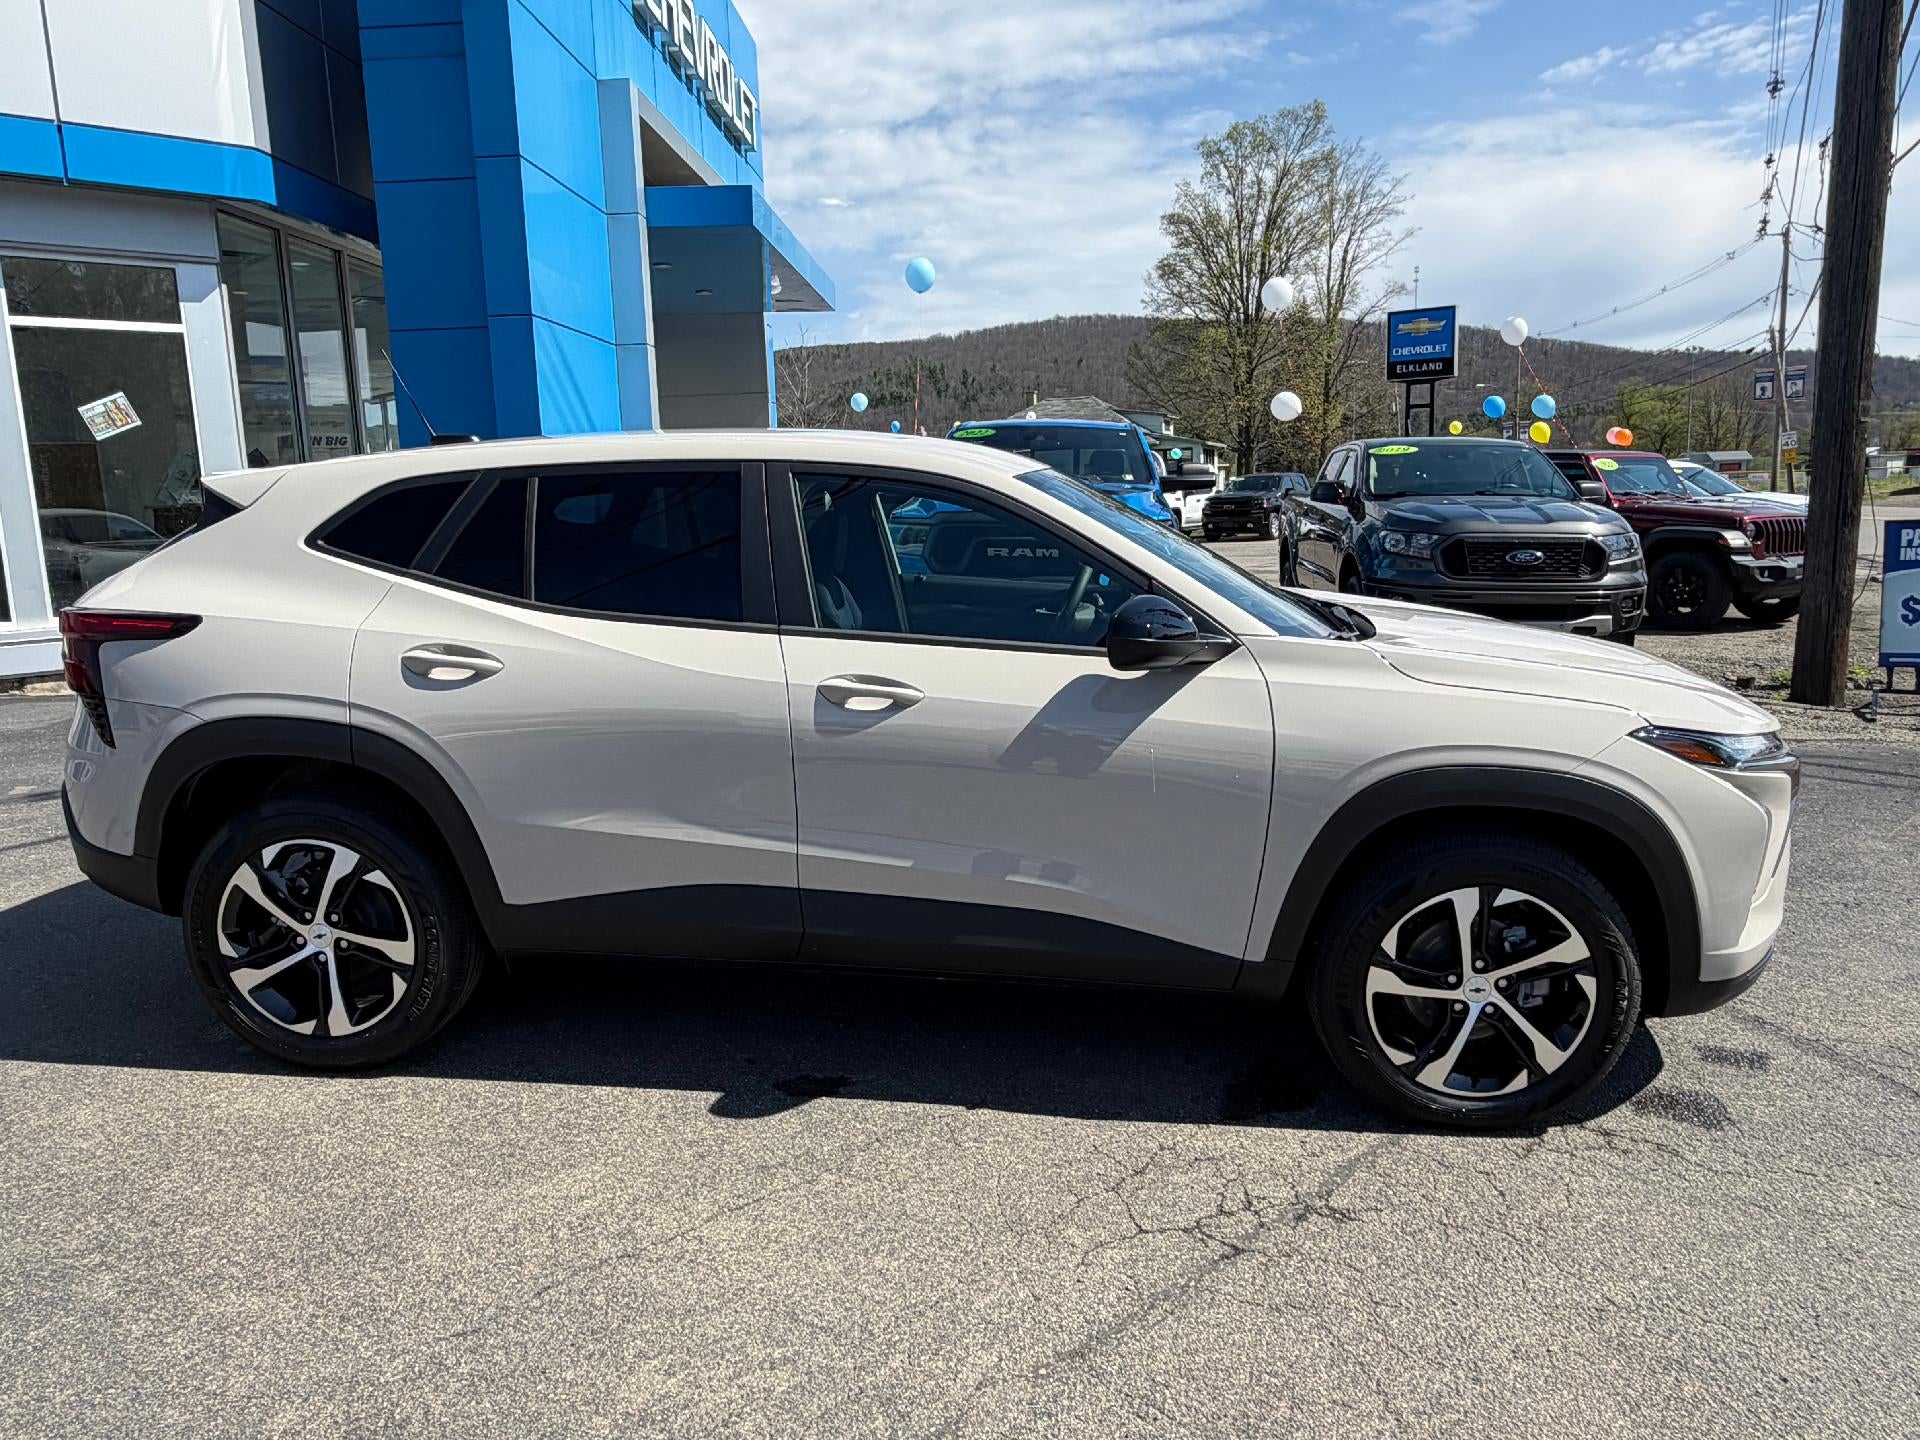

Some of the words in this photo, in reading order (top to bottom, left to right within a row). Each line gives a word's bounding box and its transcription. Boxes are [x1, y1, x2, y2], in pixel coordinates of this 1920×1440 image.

[1392, 343, 1448, 356] CHEVROLET
[1396, 362, 1443, 373] ELKLAND
[325, 435, 348, 446] BIG
[1783, 439, 1797, 447] 40
[987, 547, 1060, 558] RAM
